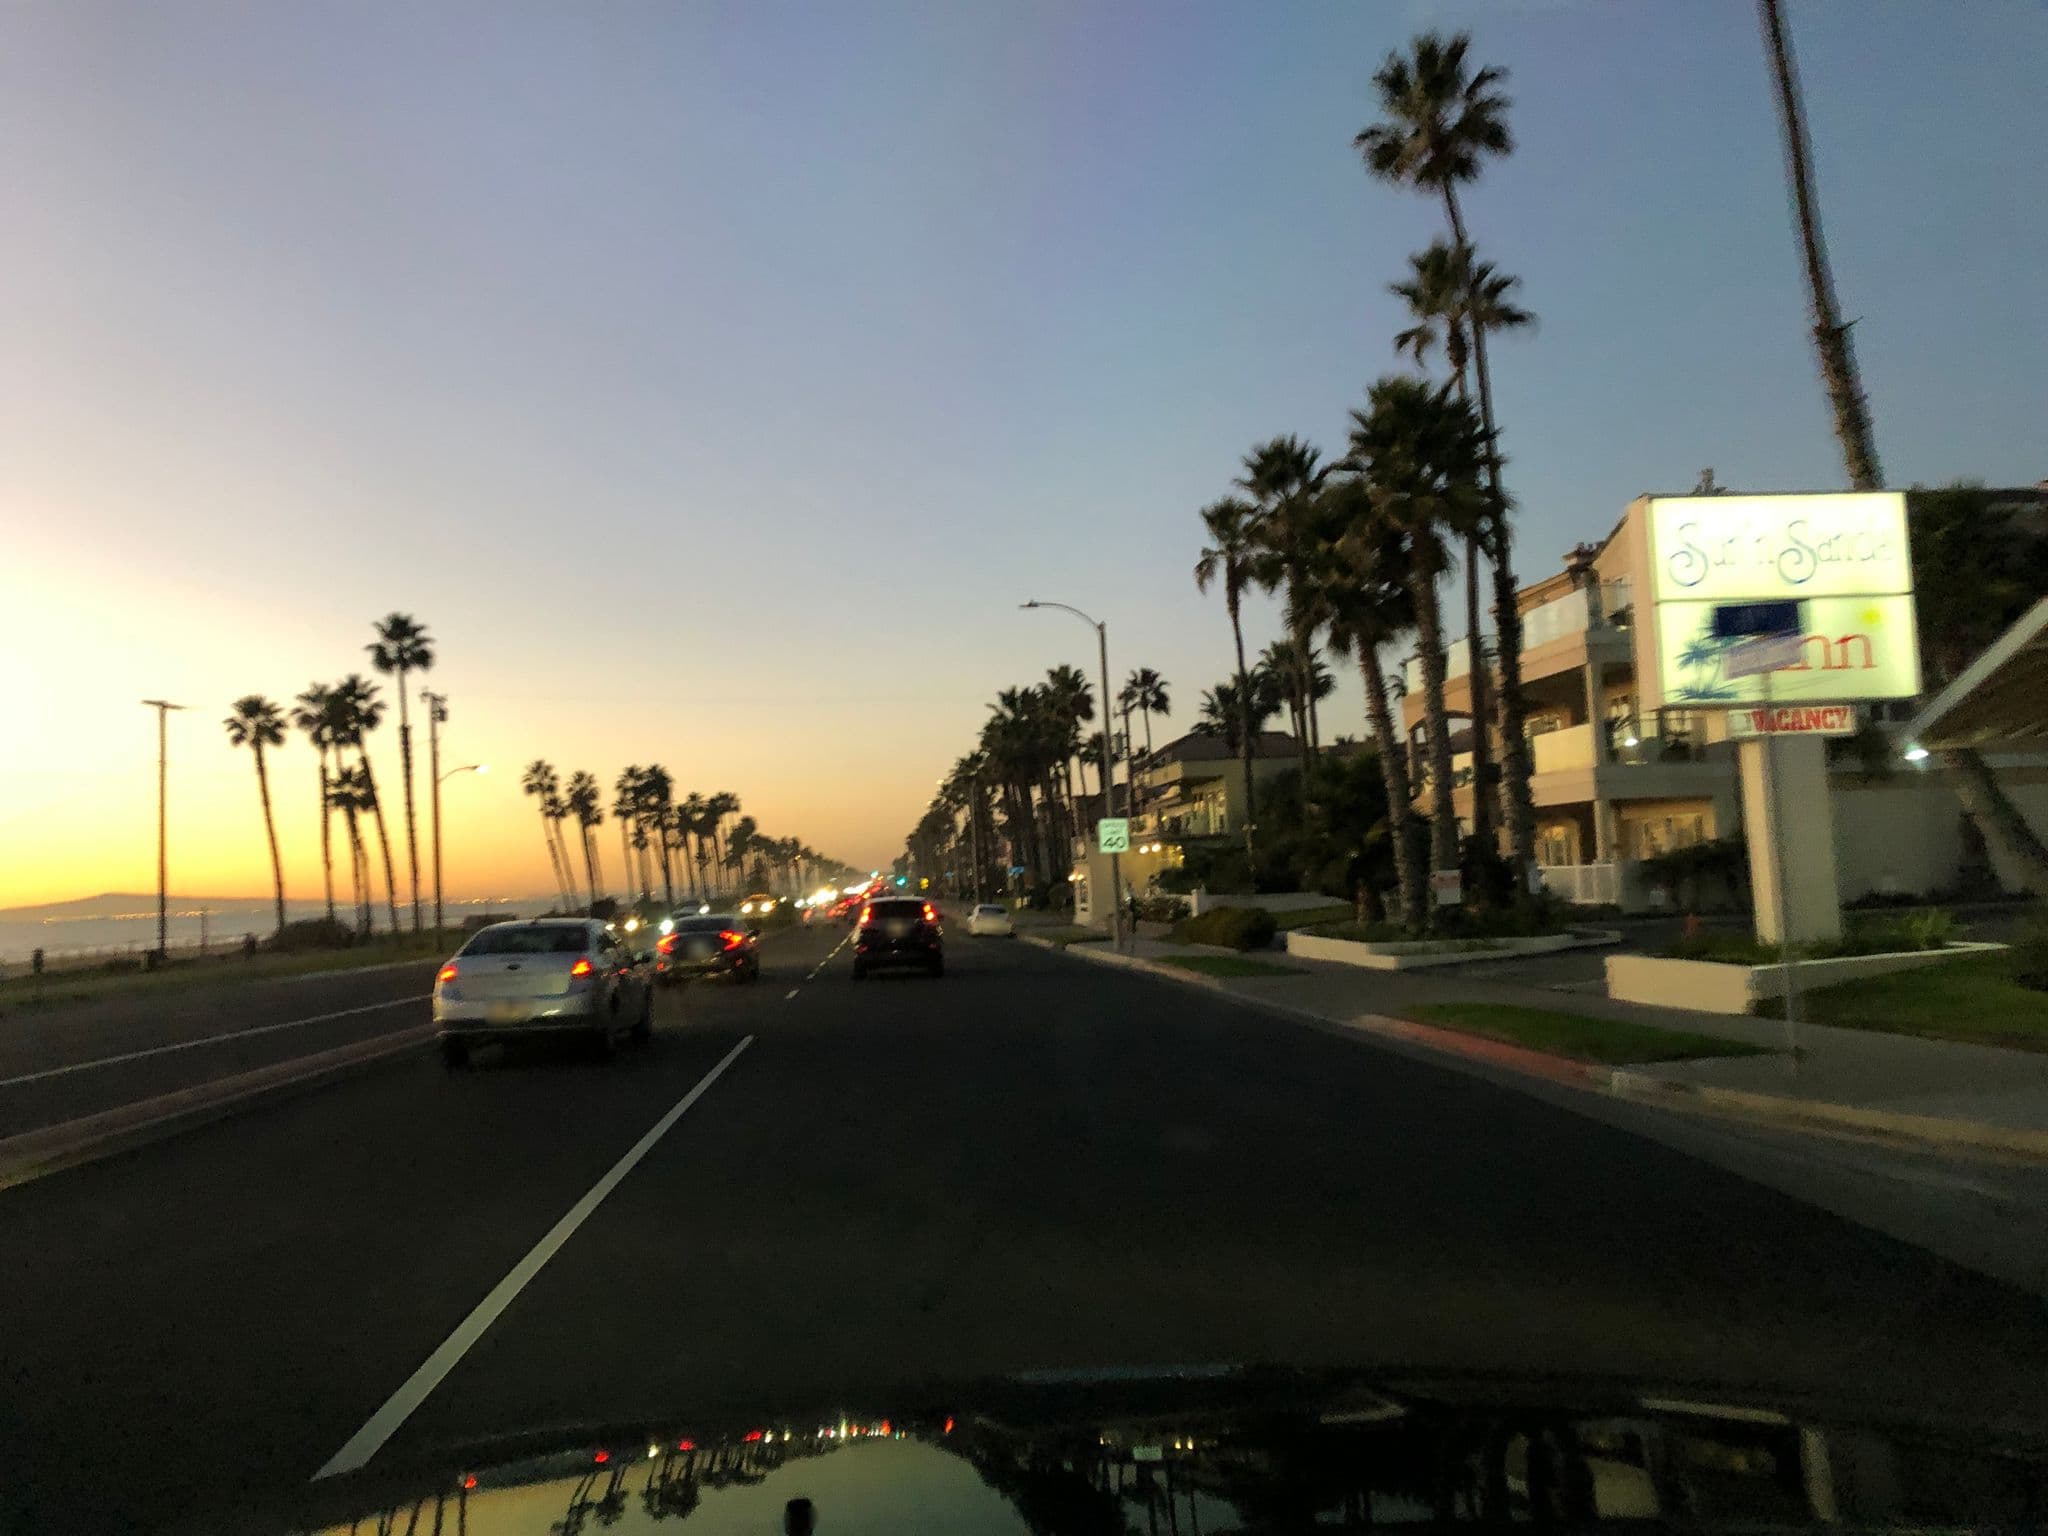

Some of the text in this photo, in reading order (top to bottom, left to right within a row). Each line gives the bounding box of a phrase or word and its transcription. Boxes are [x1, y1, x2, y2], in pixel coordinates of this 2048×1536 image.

[1775, 632, 1877, 672] nn
[1751, 707, 1849, 732] VACANCY
[1103, 836, 1127, 849] 40
